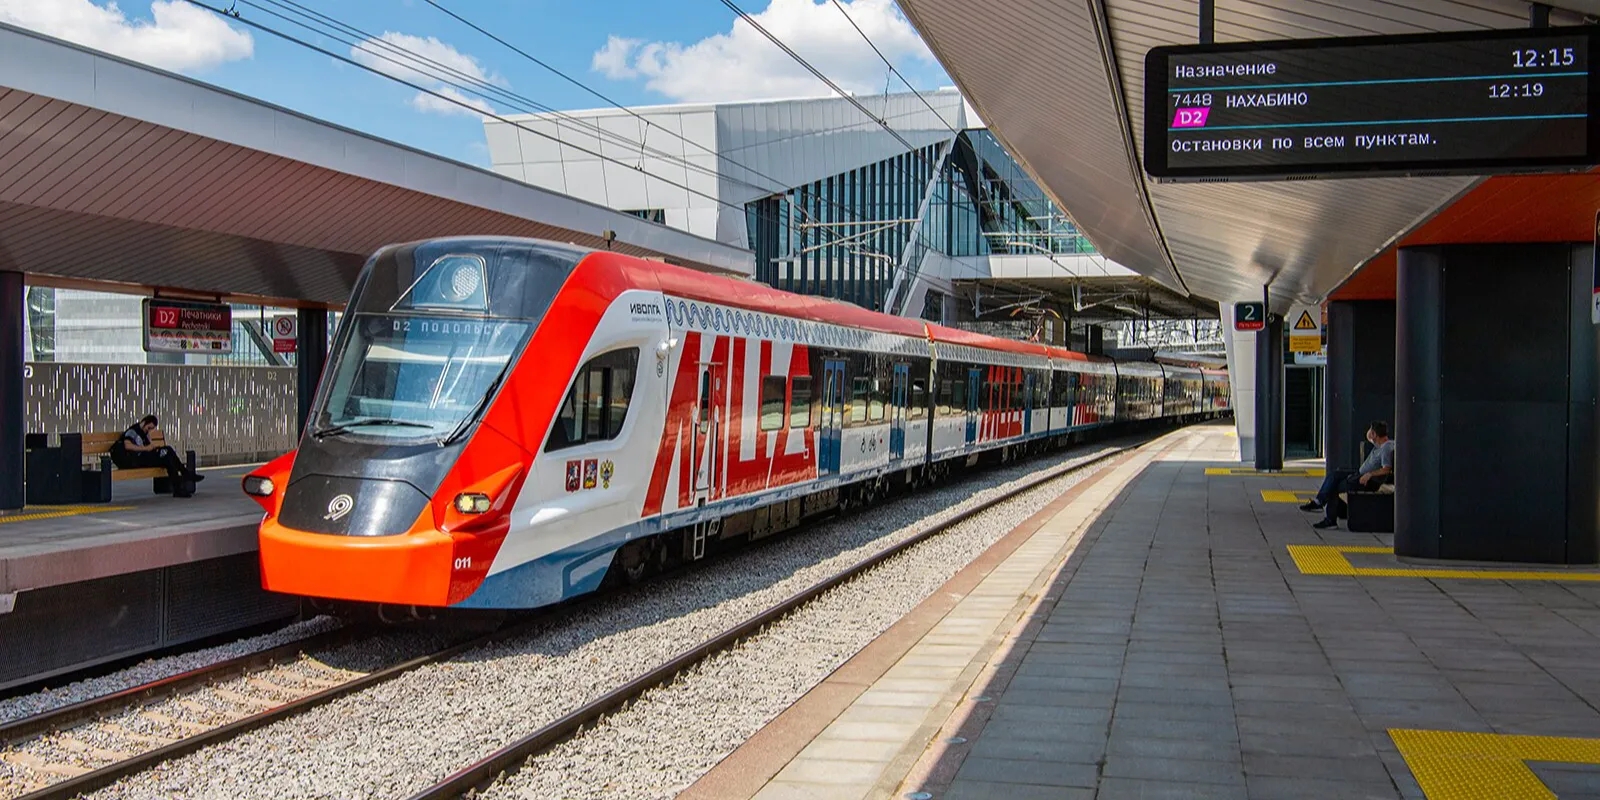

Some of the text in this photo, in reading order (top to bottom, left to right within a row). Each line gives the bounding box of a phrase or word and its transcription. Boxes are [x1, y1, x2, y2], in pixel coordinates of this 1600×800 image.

[1511, 48, 1575, 69] 12:15
[1175, 61, 1276, 79] Назначение
[1488, 83, 1543, 99] 12:19
[1172, 92, 1212, 107] 7448
[1226, 92, 1308, 108] НАХАБИНО
[1179, 110, 1203, 125] D2
[1171, 132, 1438, 153] Остановки по всем пунктам.
[159, 309, 176, 325] D2
[181, 307, 222, 322] Печатники
[629, 303, 662, 315] ИВОЛГА
[1243, 305, 1256, 321] 2
[454, 556, 472, 570] 011
